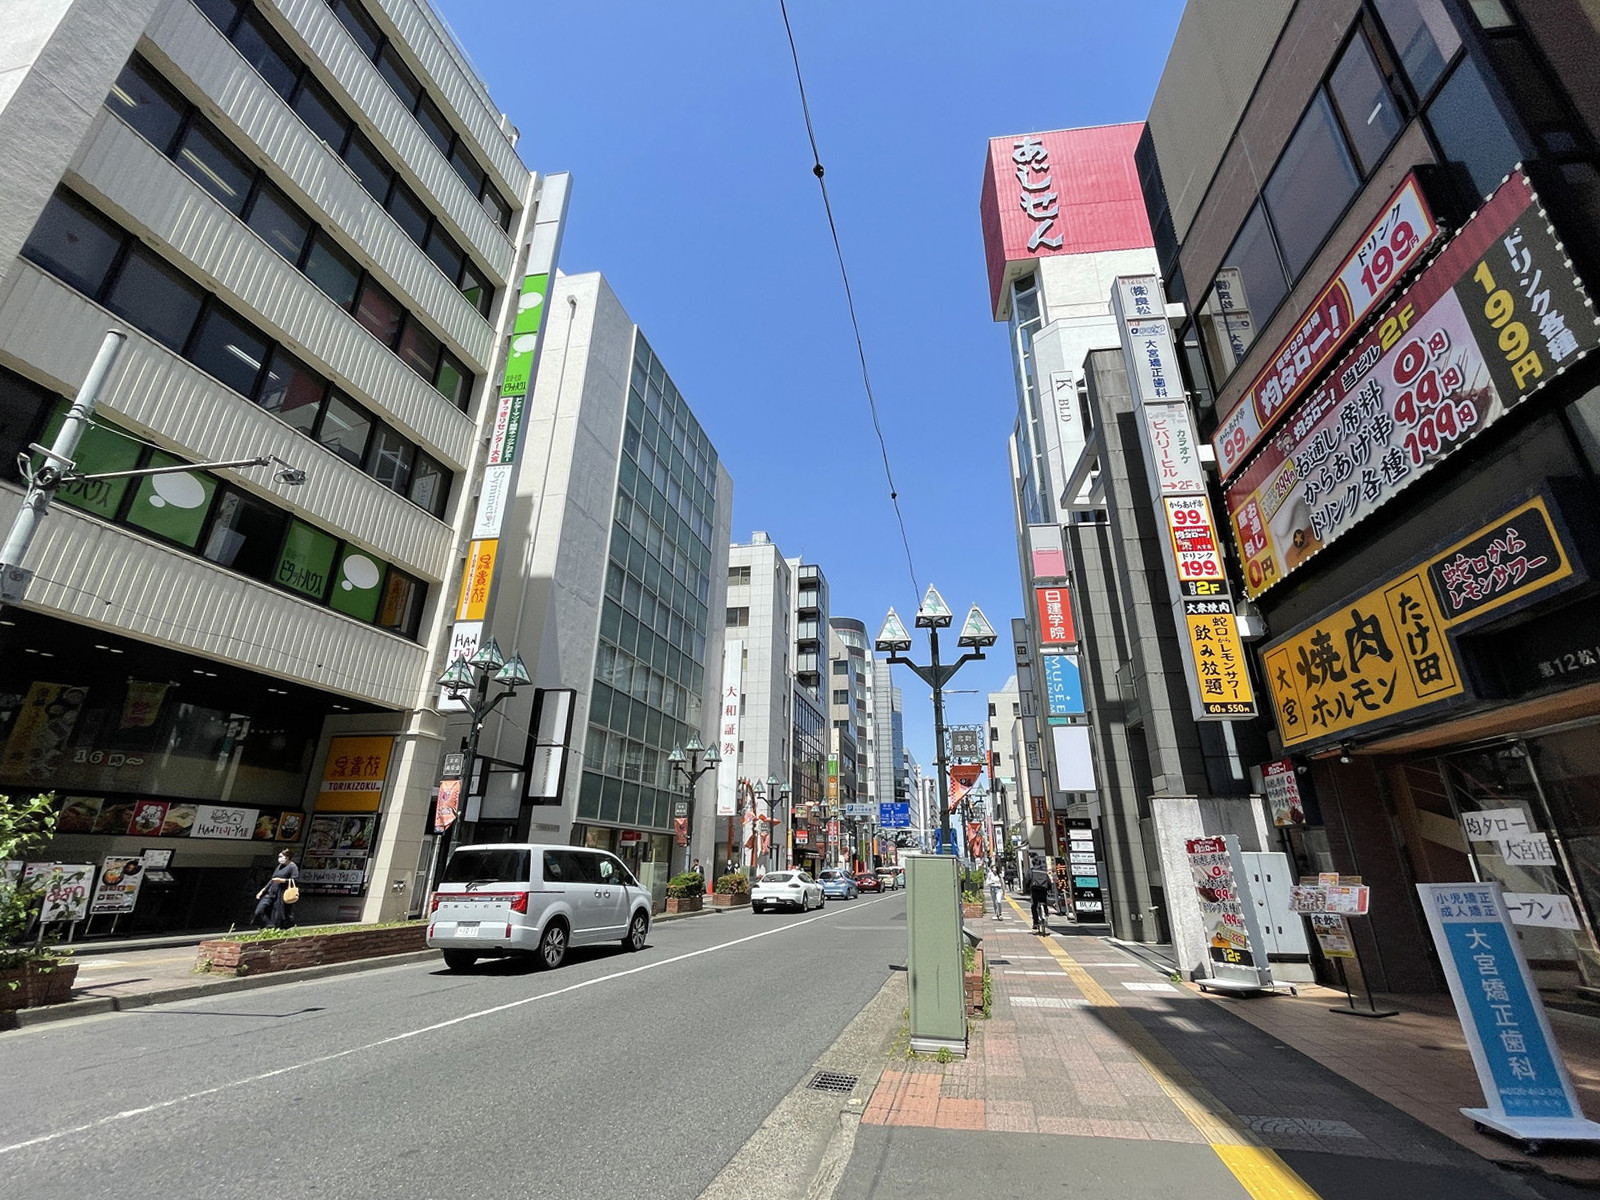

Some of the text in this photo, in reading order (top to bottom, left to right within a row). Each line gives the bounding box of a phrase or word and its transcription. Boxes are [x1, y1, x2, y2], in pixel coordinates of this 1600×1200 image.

[1012, 136, 1064, 252] あじせん
[1358, 203, 1401, 267] ドリンク
[1361, 221, 1420, 297] 199円
[1504, 227, 1579, 363] ドリンク各種
[1378, 303, 1417, 351] 2F
[1473, 260, 1544, 391] 199円
[1145, 340, 1168, 398] 大宮矯正歯科
[1260, 304, 1341, 417] 均タロー!
[1341, 345, 1380, 393] 当ビル
[1392, 328, 1449, 387] 0円
[1055, 376, 1073, 423] K BLD
[1394, 363, 1462, 427] 99円
[1177, 429, 1191, 464] カラオケ
[1303, 413, 1393, 505] からあげ串
[1403, 399, 1477, 468] 199円
[1178, 480, 1193, 490] 2F
[1309, 448, 1409, 540] ドリンク各種
[1182, 552, 1213, 560] ドリンク
[1248, 555, 1275, 589] 0円
[1442, 527, 1526, 591] 蛇口から
[1450, 555, 1548, 609] レモンサワー
[1045, 590, 1066, 639] 日建学院
[1186, 602, 1230, 614] 大衆焼肉
[1196, 581, 1220, 595] 2F
[454, 633, 478, 648] HAN
[1194, 624, 1224, 695] 飲み放題
[1296, 608, 1394, 695] 焼肉
[1398, 592, 1443, 686] たけ田
[1538, 646, 1600, 678] 第12松
[1051, 655, 1071, 713] MUSÉE
[1275, 667, 1299, 727] 大宮
[1311, 667, 1398, 728] ホルモン
[724, 685, 737, 755] 大和証券
[328, 782, 376, 791] TORIKIZOKU
[1467, 814, 1528, 835] 均タロー
[1505, 838, 1553, 862] 大宮店
[1436, 892, 1492, 905] 小児矯正
[1441, 904, 1497, 918] 成人矯正
[1464, 927, 1536, 1081] 大宮矯正歯科
